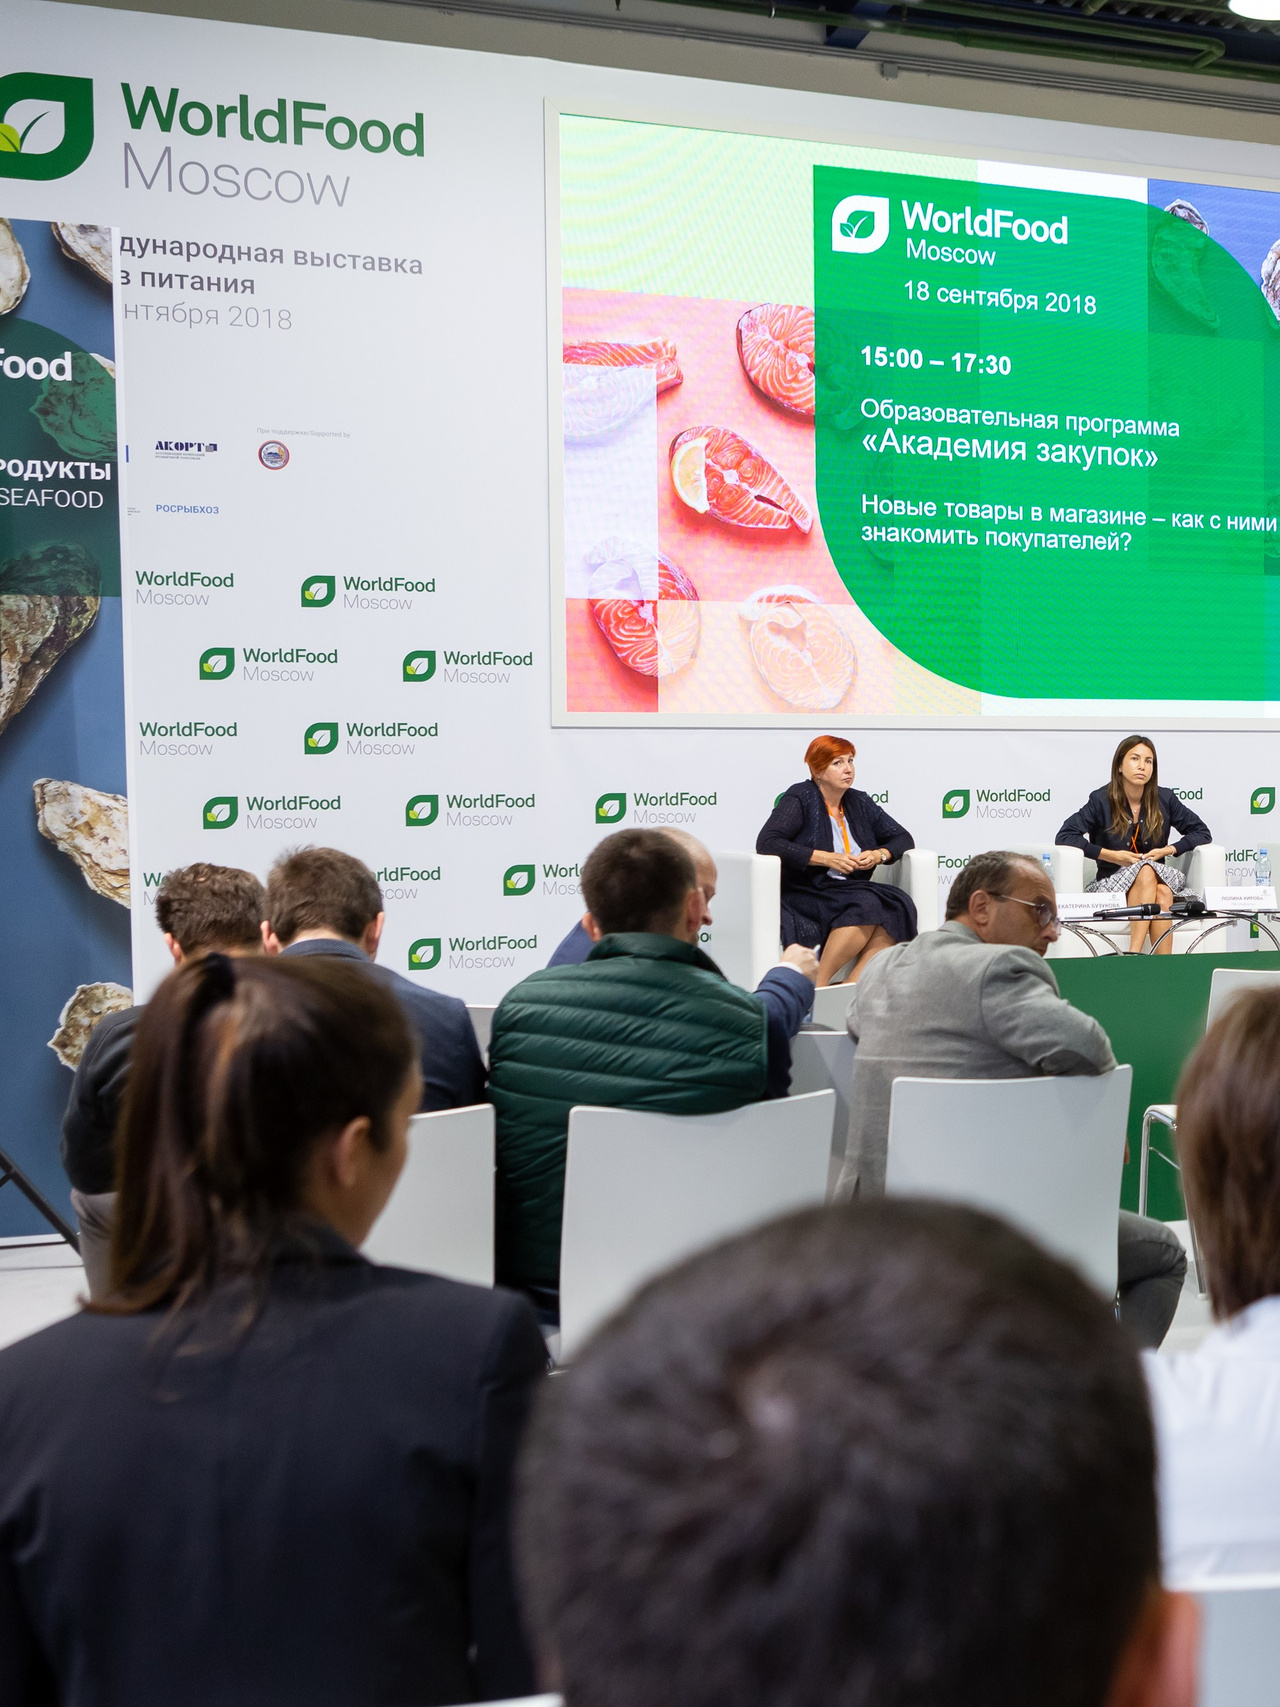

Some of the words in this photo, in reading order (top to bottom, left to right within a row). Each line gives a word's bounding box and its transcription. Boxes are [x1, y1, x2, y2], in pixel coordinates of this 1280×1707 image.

[120, 81, 426, 158] WorldFood
[122, 141, 351, 208] Moscow
[902, 200, 1068, 244] WorldFood
[120, 236, 284, 266] дународная
[294, 249, 424, 275] выставка
[906, 238, 996, 266] Moscow
[141, 269, 255, 295] питания
[904, 280, 930, 301] 18
[937, 287, 1038, 313] сентября
[1046, 292, 1097, 315] 2018
[124, 301, 219, 329] нтября
[228, 305, 293, 330] 2018
[861, 346, 923, 369] 15:00
[951, 352, 1011, 375] 17:30
[860, 398, 1058, 429] Образовательная
[1066, 415, 1180, 438] программа
[155, 440, 205, 452] АКОРТ
[862, 427, 1026, 461] «Академия
[1036, 442, 1159, 471] закупок»
[0, 487, 104, 509] SEAFOOD
[156, 504, 220, 515] РОСРЫБХОЗ
[862, 493, 937, 517] Новые
[944, 502, 1023, 524] товары
[1031, 506, 1042, 521] в
[1050, 507, 1147, 526] магазине
[1172, 512, 1204, 529] как
[1209, 514, 1221, 530] с
[1227, 515, 1278, 532] ними
[861, 525, 979, 546] знакомить
[985, 530, 1132, 552] покупателей?
[135, 571, 234, 588] WorldFood
[343, 576, 436, 593] WorldFood
[135, 589, 209, 606] Moscow
[343, 593, 412, 610] Moscow
[243, 648, 338, 664] WorldFood
[443, 650, 533, 666] WorldFood
[243, 666, 314, 682] Moscow
[443, 668, 510, 684] Moscow
[139, 722, 238, 737] WorldFood
[346, 722, 439, 738] WorldFood
[139, 740, 213, 756] Moscow
[346, 740, 416, 755] Moscow
[246, 795, 341, 811] WorldFood
[446, 794, 535, 808] WorldFood
[634, 792, 717, 806] WorldFood
[976, 789, 1051, 803] WorldFood
[446, 812, 513, 827] Moscow
[634, 809, 696, 824] Moscow
[976, 805, 1032, 819] Moscow
[246, 814, 318, 830] Moscow
[374, 866, 441, 882] rldFood
[449, 935, 537, 952] WorldFood
[449, 954, 515, 969] Moscow
